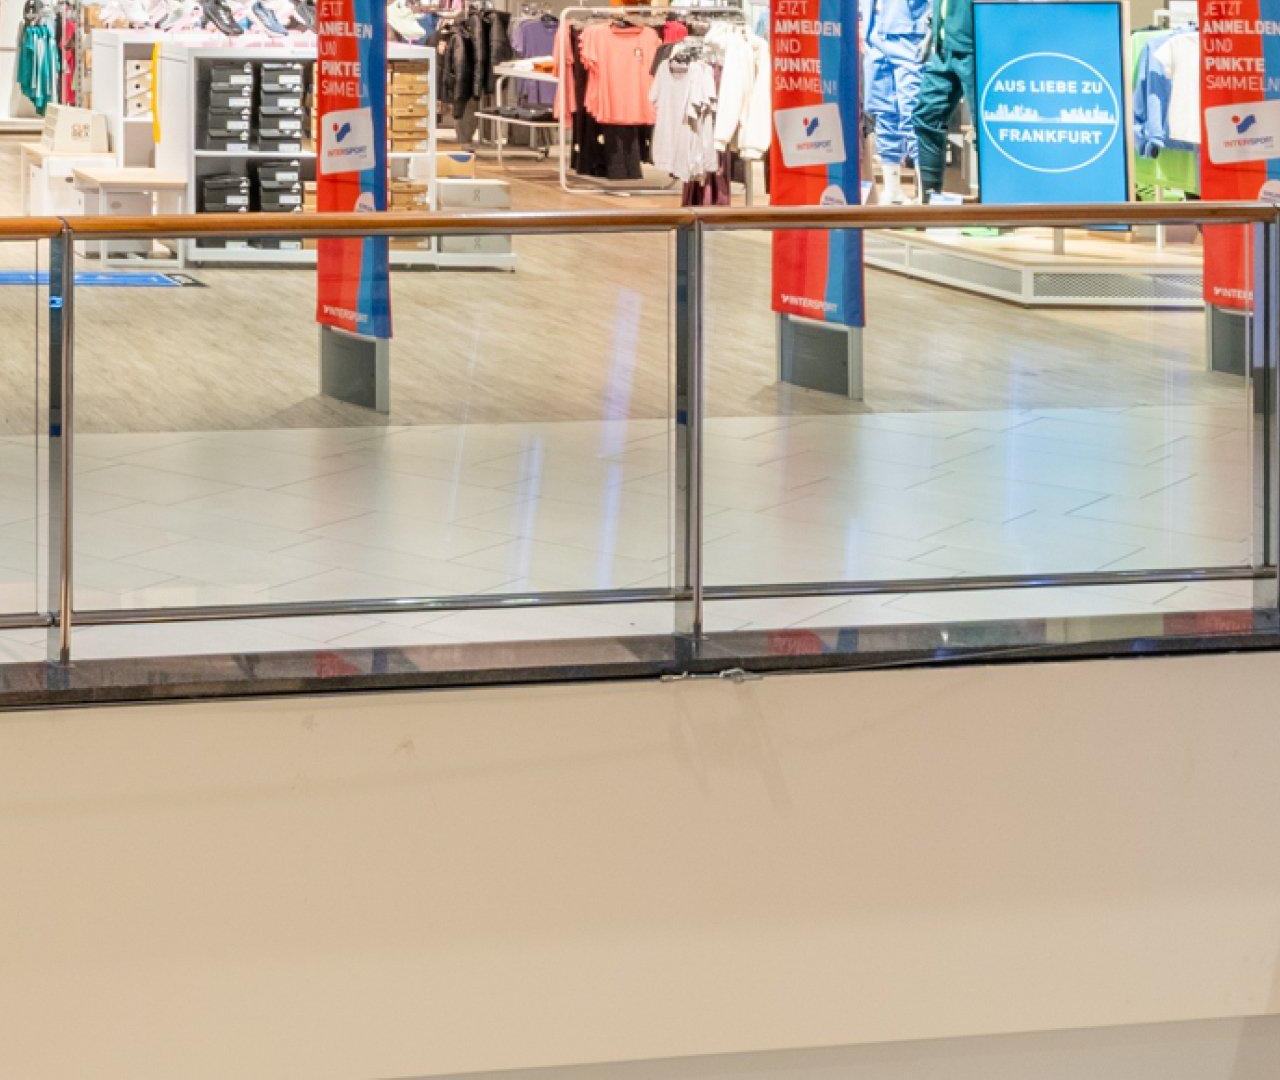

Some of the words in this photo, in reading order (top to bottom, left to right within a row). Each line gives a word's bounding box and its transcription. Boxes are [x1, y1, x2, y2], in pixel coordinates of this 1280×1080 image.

[1203, 0, 1242, 16] JETZT
[1204, 37, 1233, 53] UND
[1205, 57, 1264, 72] PUNKTE
[994, 80, 1026, 93] AUS
[1030, 80, 1077, 94] LIEBE
[1081, 81, 1103, 94] ZU
[999, 128, 1102, 145] FRANKFURT
